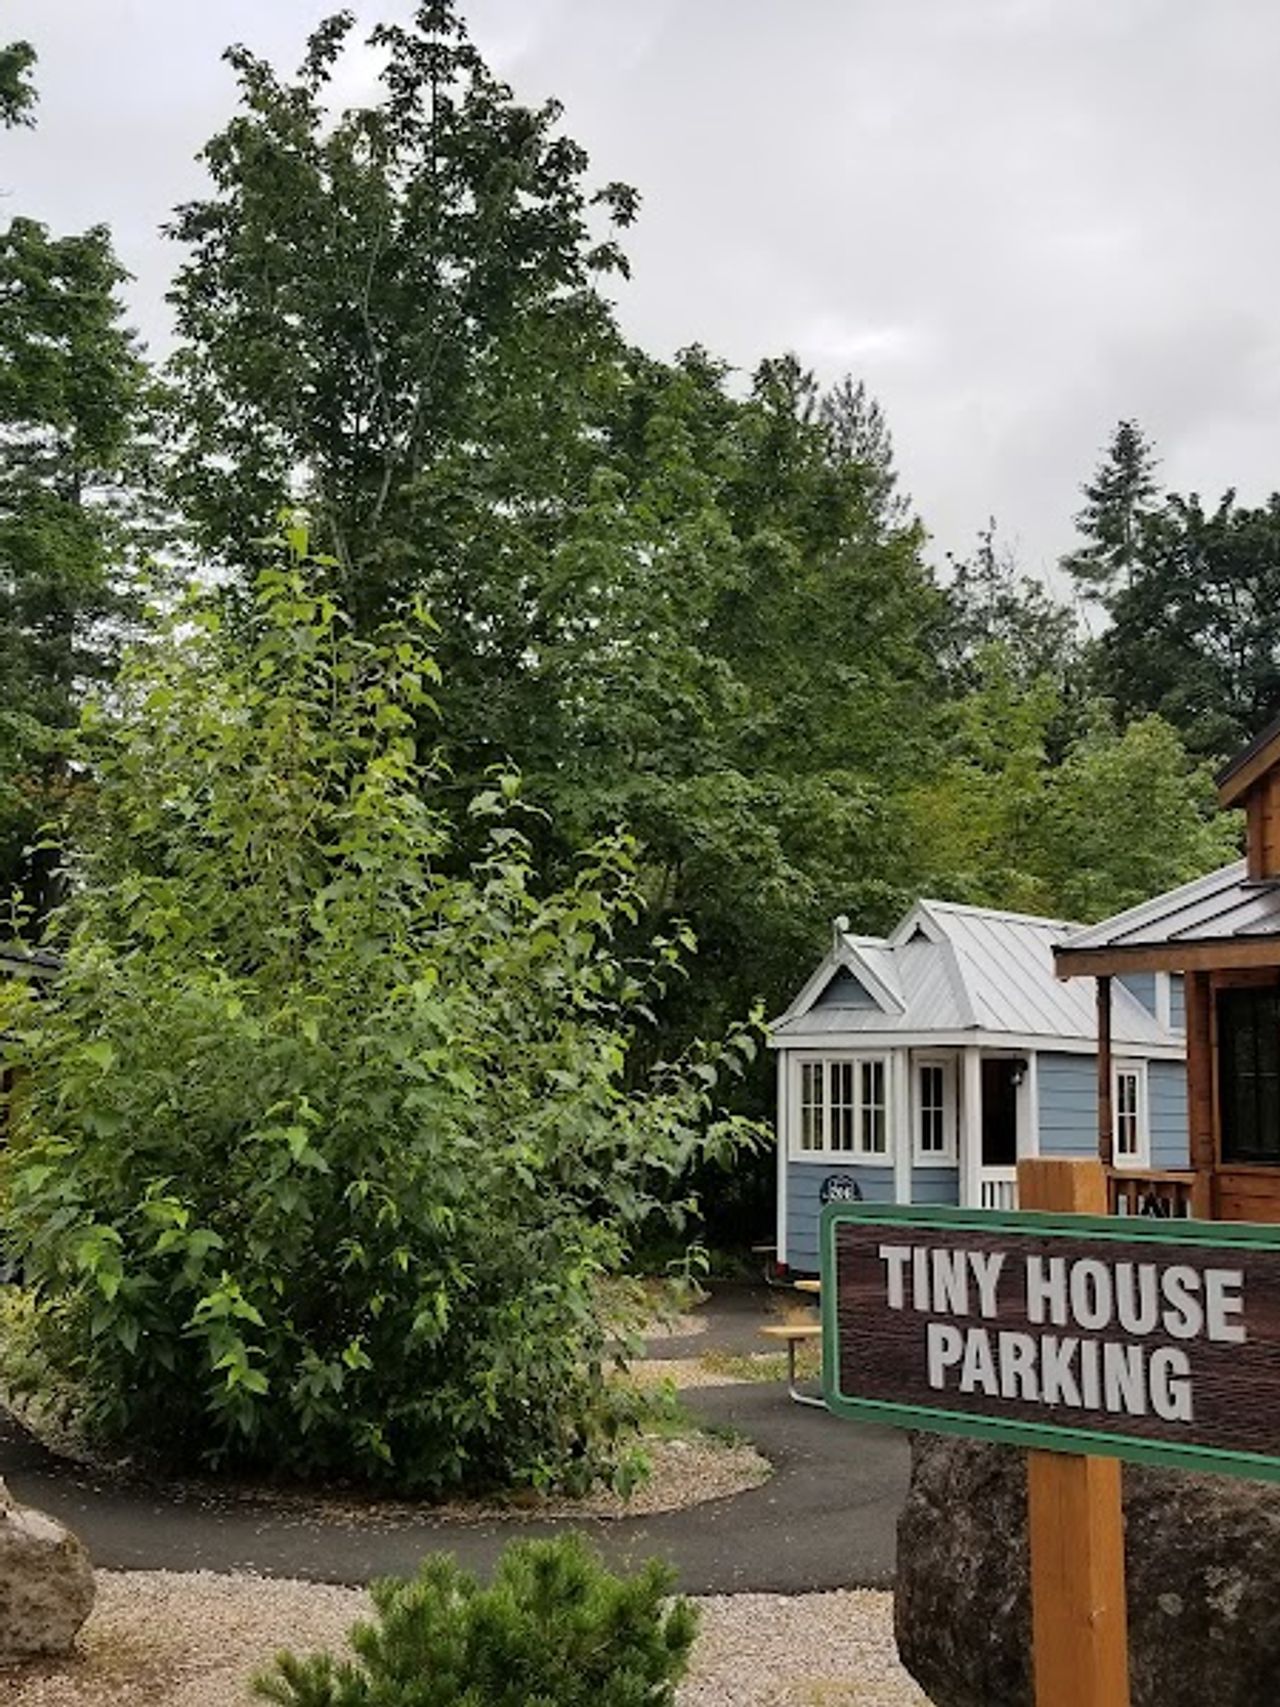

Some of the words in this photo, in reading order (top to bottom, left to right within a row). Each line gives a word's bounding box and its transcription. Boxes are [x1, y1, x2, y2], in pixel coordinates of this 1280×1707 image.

[879, 1245, 1006, 1319] TINY
[1026, 1255, 1247, 1344] HOUSE
[927, 1323, 1194, 1422] PARKING
